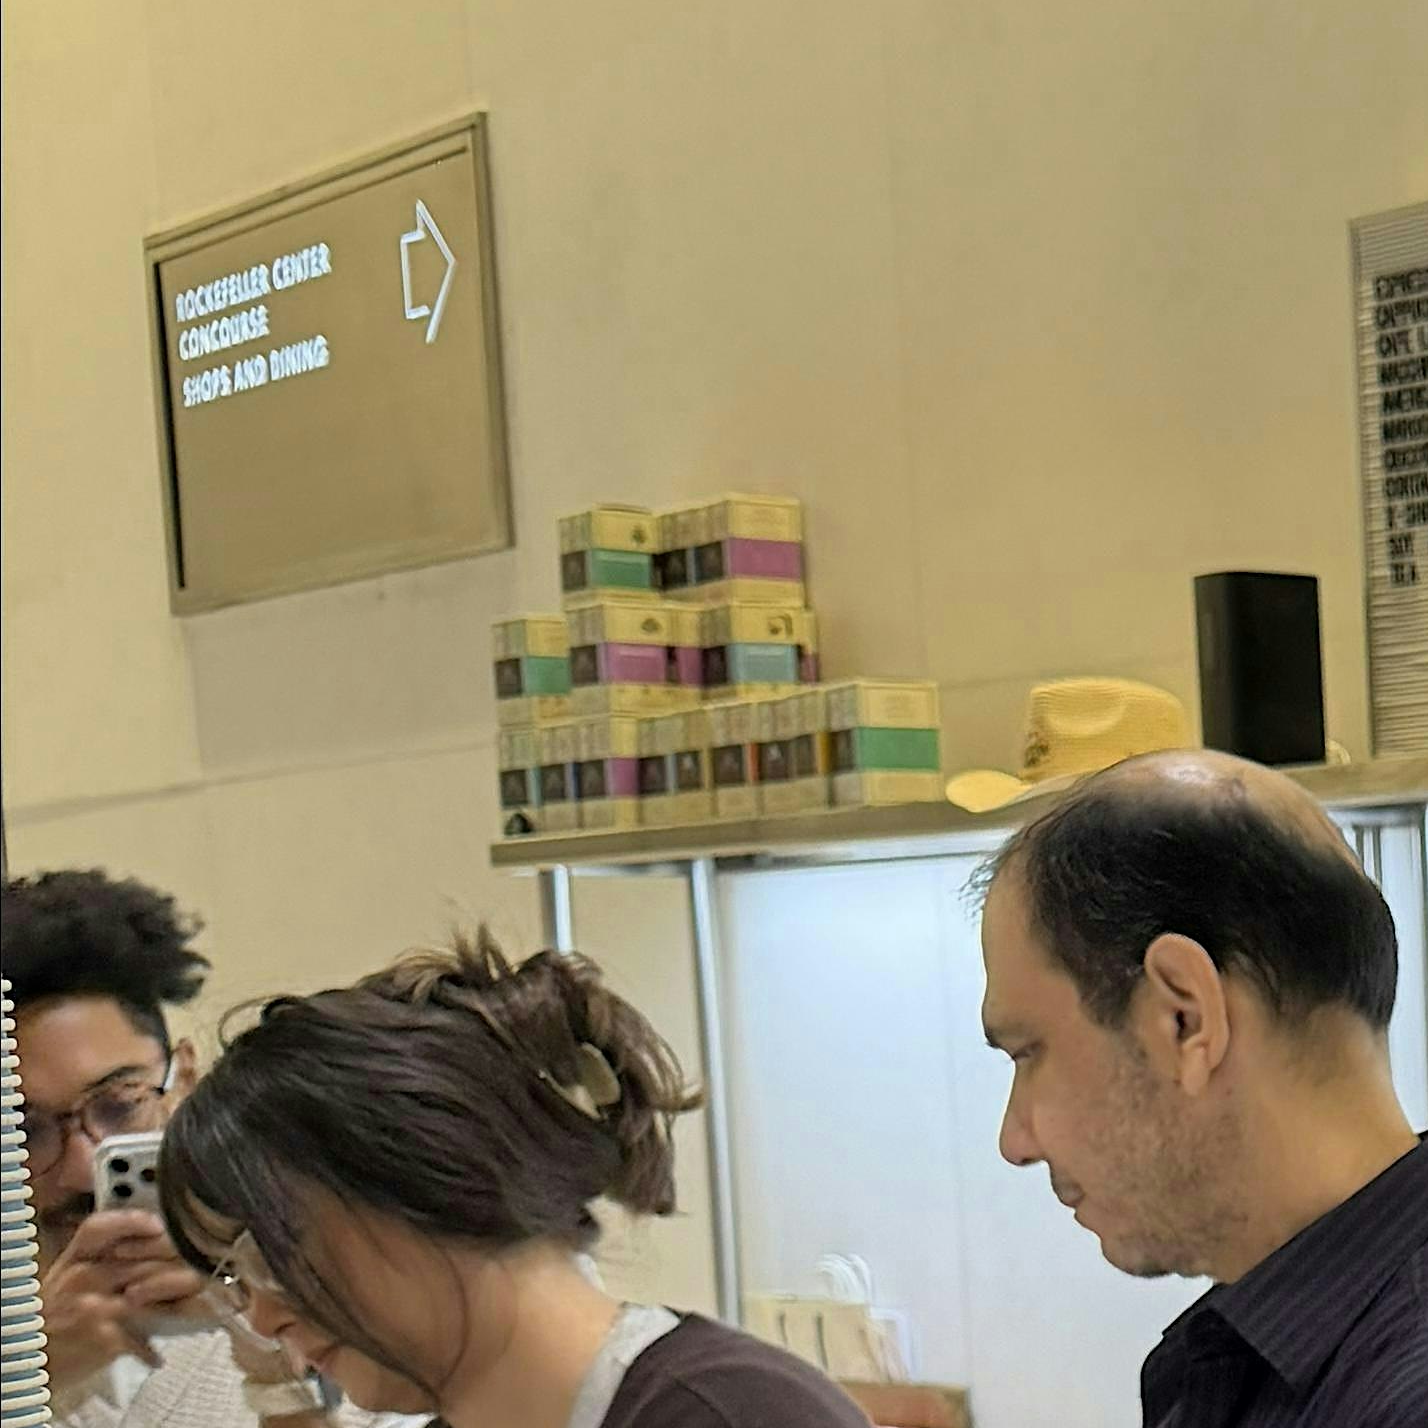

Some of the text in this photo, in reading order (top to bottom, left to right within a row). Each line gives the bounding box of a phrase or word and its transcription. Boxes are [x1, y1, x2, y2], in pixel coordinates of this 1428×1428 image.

[176, 242, 332, 322] ROCKEFELLER CENTER
[179, 304, 269, 361] CONCOURSE
[183, 335, 329, 408] SHOPS AND DINING
